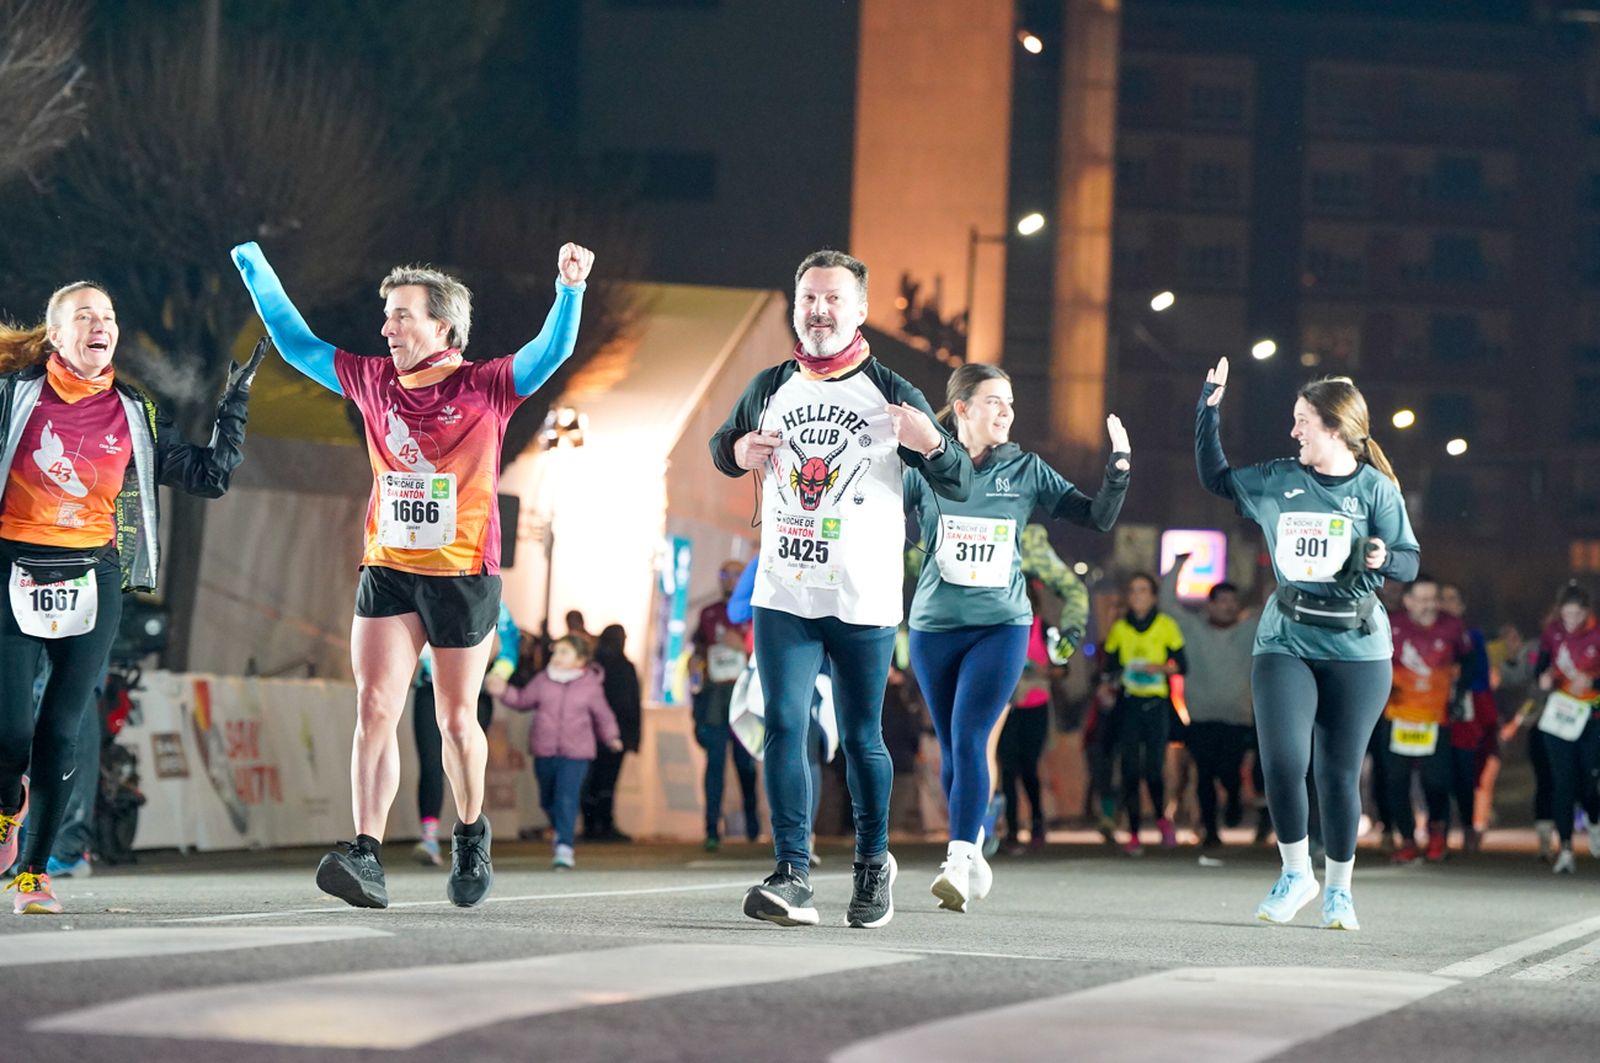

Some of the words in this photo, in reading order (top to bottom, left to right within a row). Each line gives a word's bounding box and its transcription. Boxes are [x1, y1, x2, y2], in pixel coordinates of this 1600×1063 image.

[800, 428, 840, 445] CLUB
[399, 444, 418, 464] 43
[48, 461, 72, 482] 43
[415, 481, 425, 490] DE
[392, 499, 439, 524] 1666
[804, 519, 815, 528] DE
[778, 536, 829, 564] 3425
[956, 541, 996, 563] 3117
[1295, 537, 1328, 558] 901
[29, 588, 79, 612] 1667
